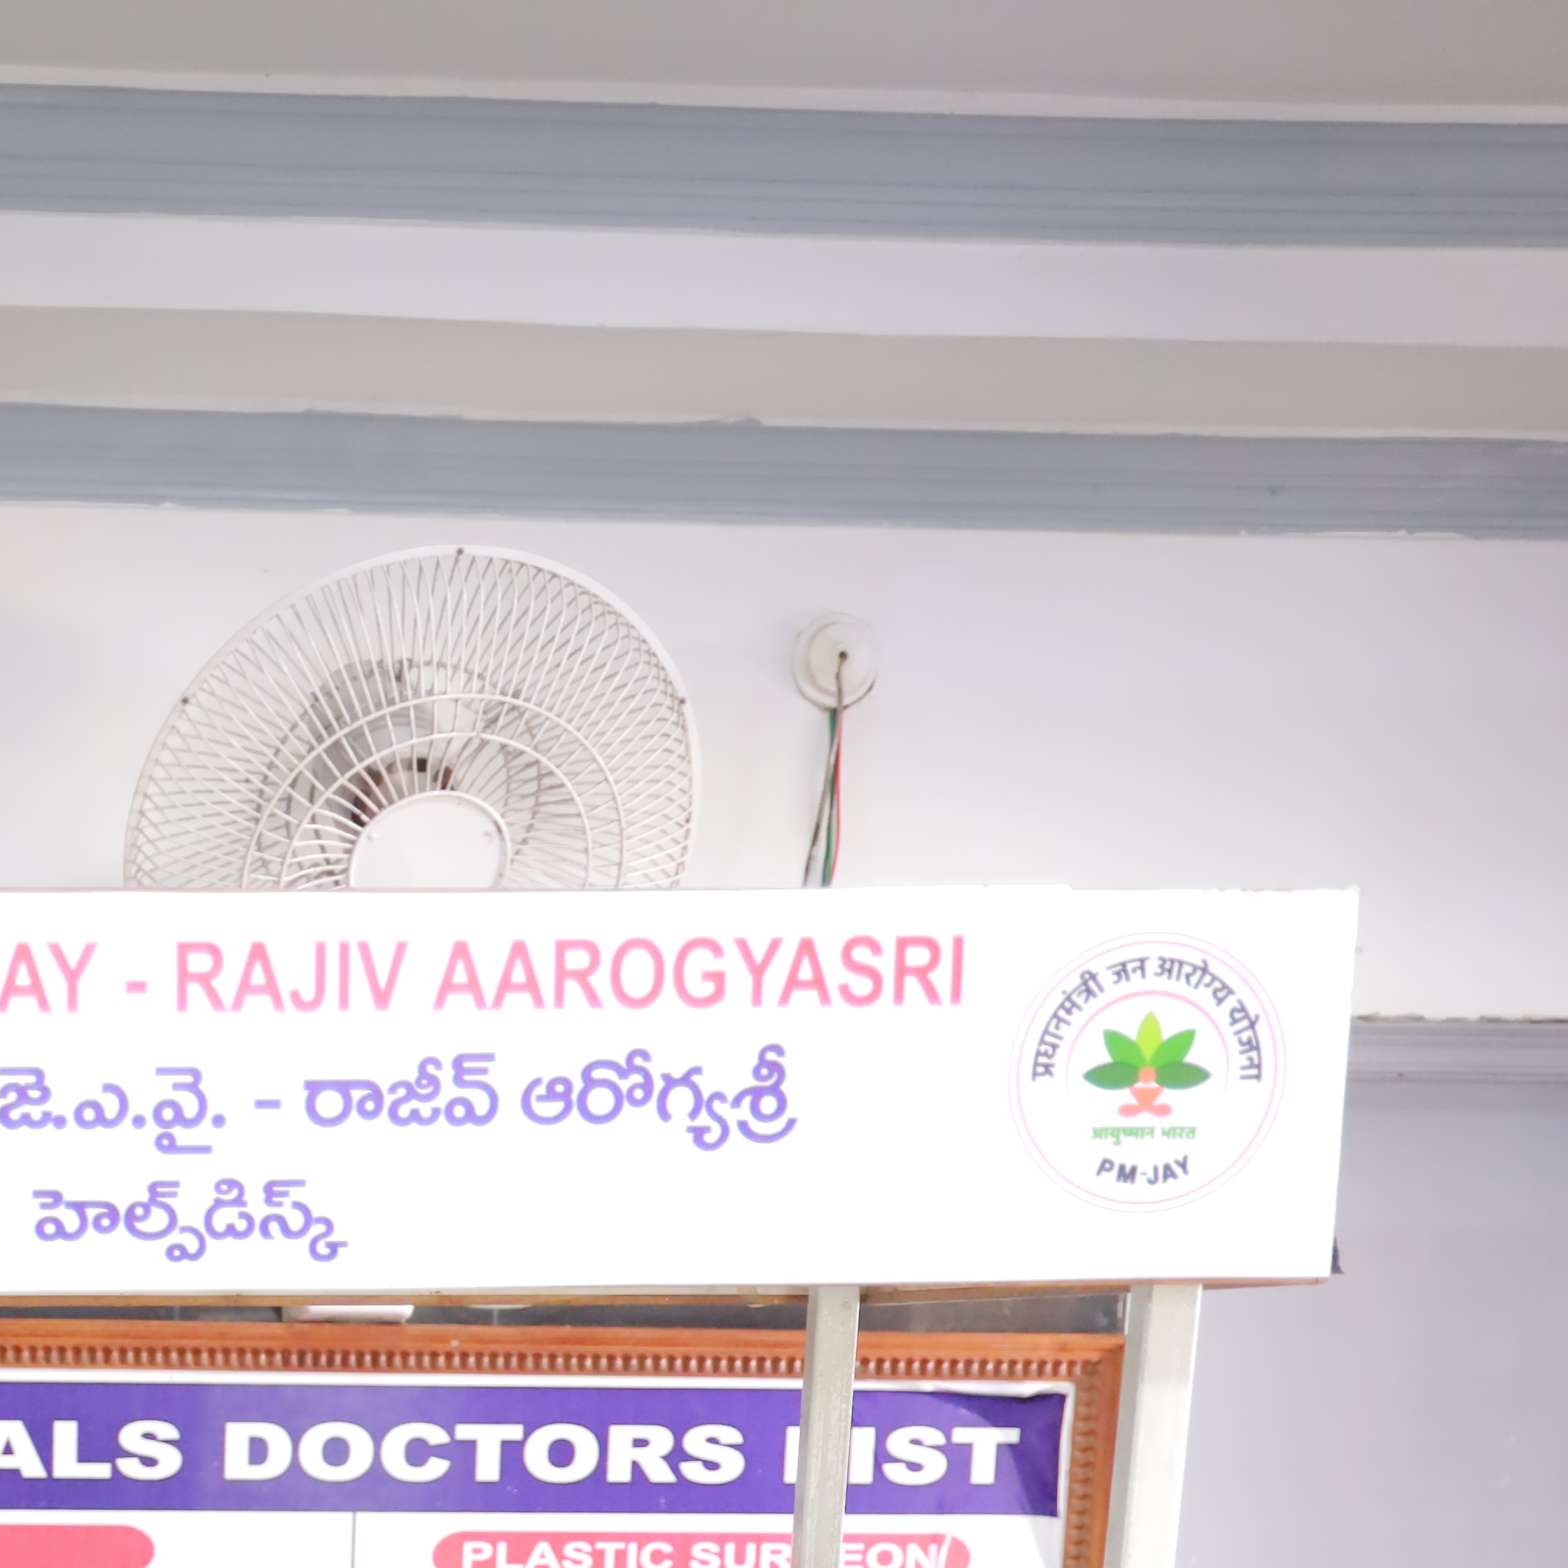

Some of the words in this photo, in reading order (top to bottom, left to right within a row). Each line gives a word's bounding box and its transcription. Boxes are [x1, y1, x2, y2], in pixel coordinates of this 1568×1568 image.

[177, 941, 407, 1012] RAJIV
[434, 935, 964, 1009] AAROGYASRI
[1032, 968, 1106, 1082] प्रधानमंत्री
[1106, 956, 1150, 984] जन
[1154, 956, 1236, 1008] आरोग्य
[1228, 998, 1262, 1082] योजना
[304, 1053, 498, 1127] రాజీవ్
[521, 1044, 797, 1151] ఆరోగ్యశ్రీ
[1161, 1126, 1197, 1140] भारत
[1097, 1155, 1188, 1185] PM-JAY
[224, 1422, 745, 1485] DOCTORS
[783, 1426, 1019, 1486] IST
